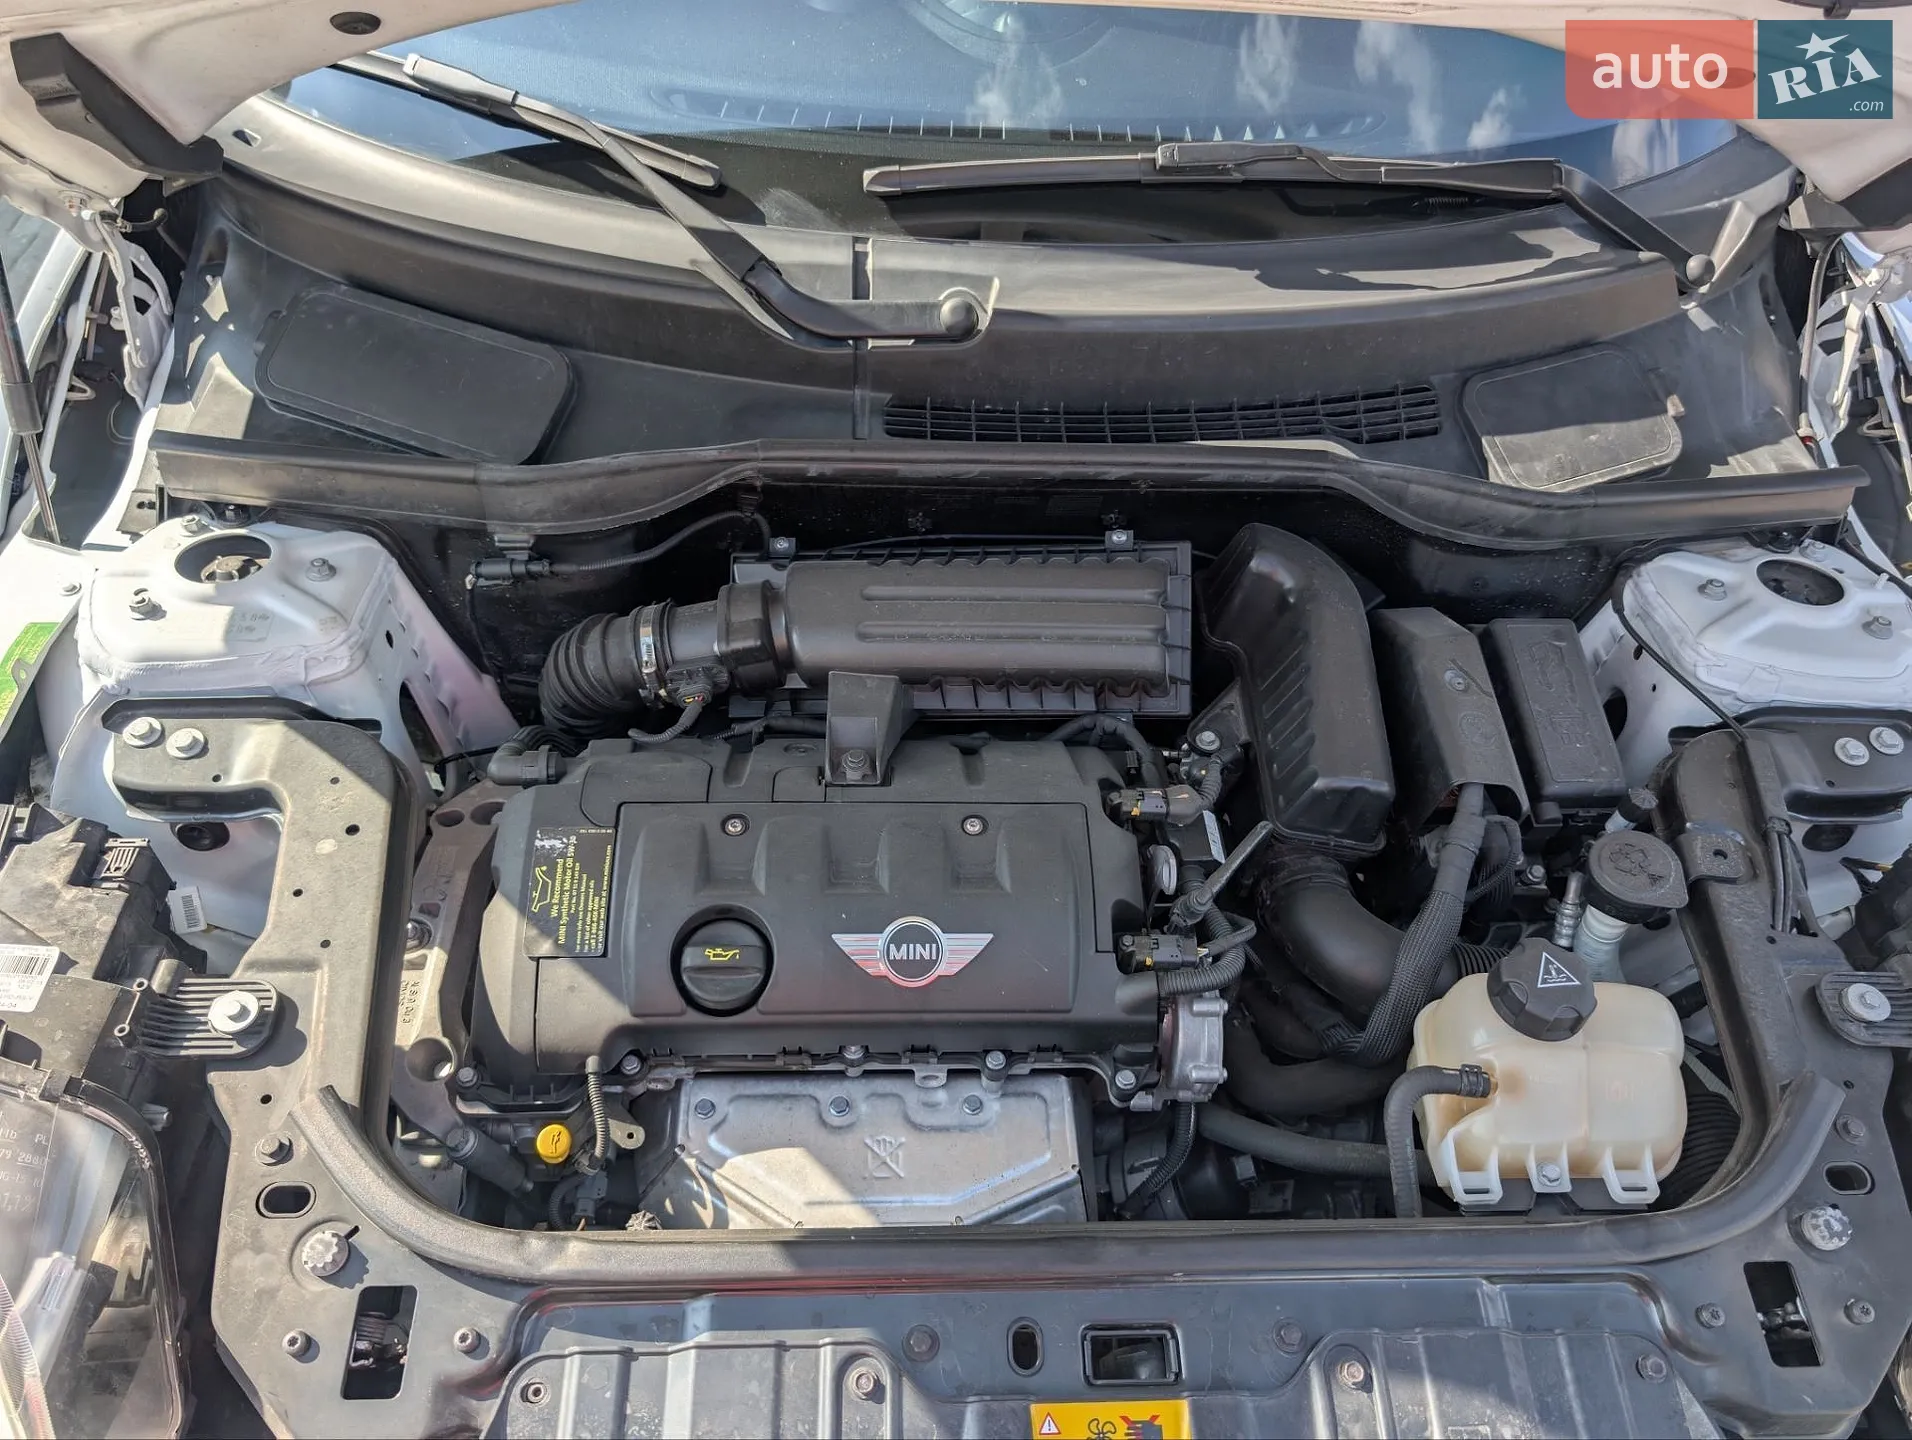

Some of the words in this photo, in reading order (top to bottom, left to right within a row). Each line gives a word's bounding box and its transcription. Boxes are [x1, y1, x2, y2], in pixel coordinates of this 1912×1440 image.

[552, 859, 563, 904] Recommend
[564, 869, 572, 890] Motor
[550, 905, 559, 917] We
[560, 891, 570, 924] Synthetic
[558, 926, 566, 944] MINI
[889, 943, 937, 960] MINI
